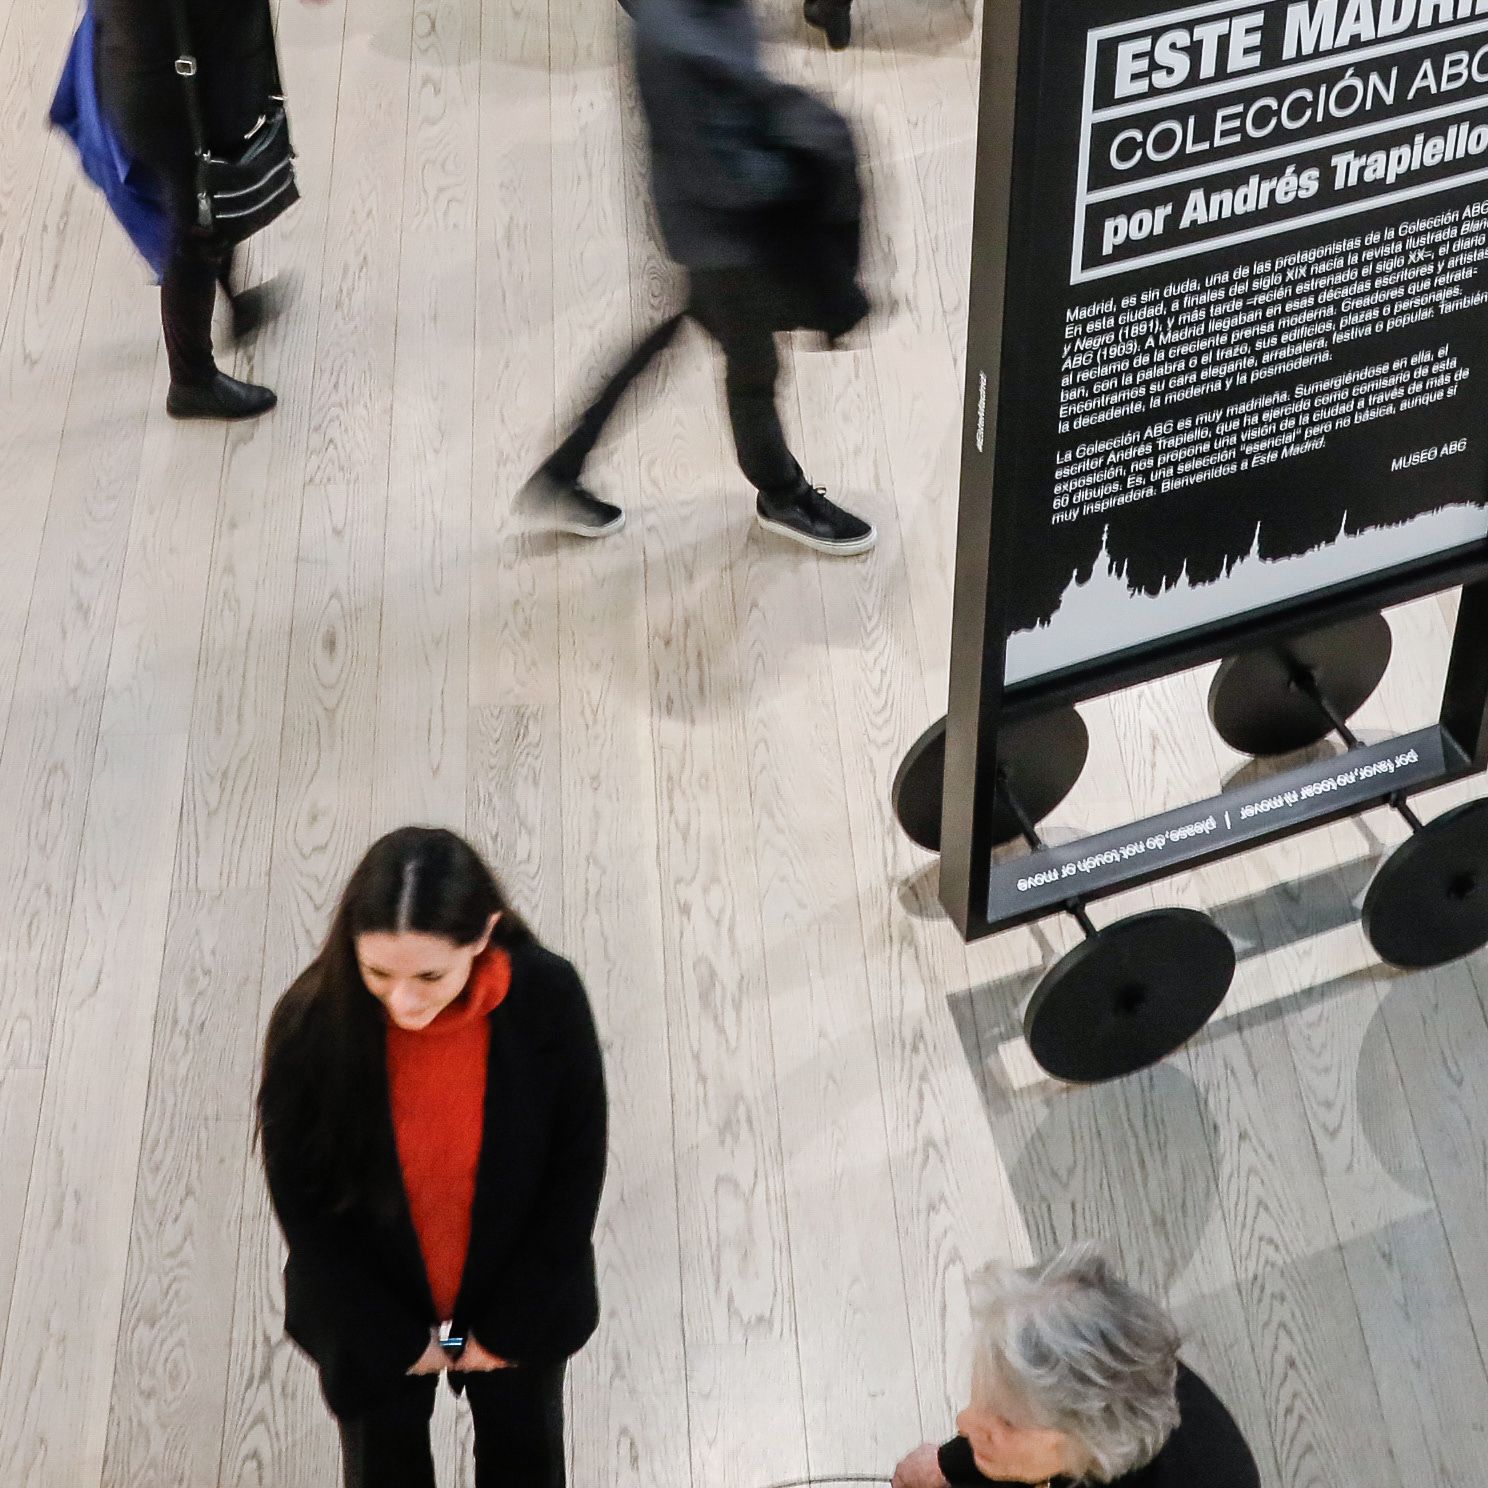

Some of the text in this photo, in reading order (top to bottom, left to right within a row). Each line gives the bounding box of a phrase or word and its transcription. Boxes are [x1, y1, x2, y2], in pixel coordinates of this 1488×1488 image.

[1113, 9, 1265, 99] ESTE
[1109, 65, 1398, 170] COLECCIÓN
[1101, 201, 1173, 256] por
[1178, 163, 1320, 230] Andrés
[1061, 343, 1071, 358] y
[1073, 331, 1115, 356] Negro
[1166, 316, 1175, 331] y
[1178, 307, 1206, 325] más
[1209, 298, 1243, 317] tarde
[1295, 267, 1358, 294] estrenado
[1361, 261, 1373, 277] el
[1375, 254, 1405, 274] siglo
[1438, 241, 1450, 256] el
[1452, 233, 1486, 252] diario
[1061, 350, 1093, 371] ABC
[1144, 335, 1155, 349] A
[1158, 321, 1205, 346] Madrid
[1208, 308, 1262, 333] llegaban
[1265, 303, 1282, 317] en
[1284, 294, 1315, 312] esas
[1317, 279, 1371, 304] décadas
[1374, 262, 1434, 288] escritores
[1436, 259, 1445, 274] y
[1064, 324, 1082, 339] En
[1085, 315, 1115, 333] esta
[1118, 300, 1167, 328] ciudad,
[1170, 299, 1179, 312] a
[1183, 287, 1225, 308] finales
[1228, 278, 1249, 296] del
[1251, 272, 1282, 291] siglo
[1285, 263, 1307, 282] XIX
[1310, 255, 1344, 275] nacía
[1347, 252, 1358, 266] la
[1361, 240, 1402, 262] revista
[1405, 225, 1458, 250] ilustrada
[1065, 298, 1116, 327] Madrid,
[1120, 294, 1137, 308] es
[1140, 288, 1160, 304] sin
[1162, 278, 1200, 302] duda,
[1205, 270, 1229, 287] una
[1232, 264, 1250, 280] de
[1252, 259, 1272, 275] las
[1274, 236, 1361, 272] protagonistas
[1364, 230, 1381, 246] de
[1383, 227, 1395, 241] la
[1398, 210, 1459, 236] Colección
[1059, 291, 1488, 418] Encontramos su cara elegante, arrabalera, festiva o popular. También
[1060, 284, 1462, 406] ban, con la palabra o el trazo, sus edificios, plazas o personajes.
[1061, 371, 1073, 387] al
[1076, 358, 1129, 383] reclamo
[1132, 353, 1150, 368] de
[1153, 348, 1165, 362] la
[1168, 330, 1228, 358] creciente
[1230, 320, 1274, 344] prensa
[1277, 304, 1337, 329] moderna.
[1341, 285, 1405, 312] Creadores
[1407, 278, 1431, 295] que
[1058, 349, 1332, 434] la decadente, la moderna y la posmoderna.
[1391, 438, 1467, 472] MUSEO ABC
